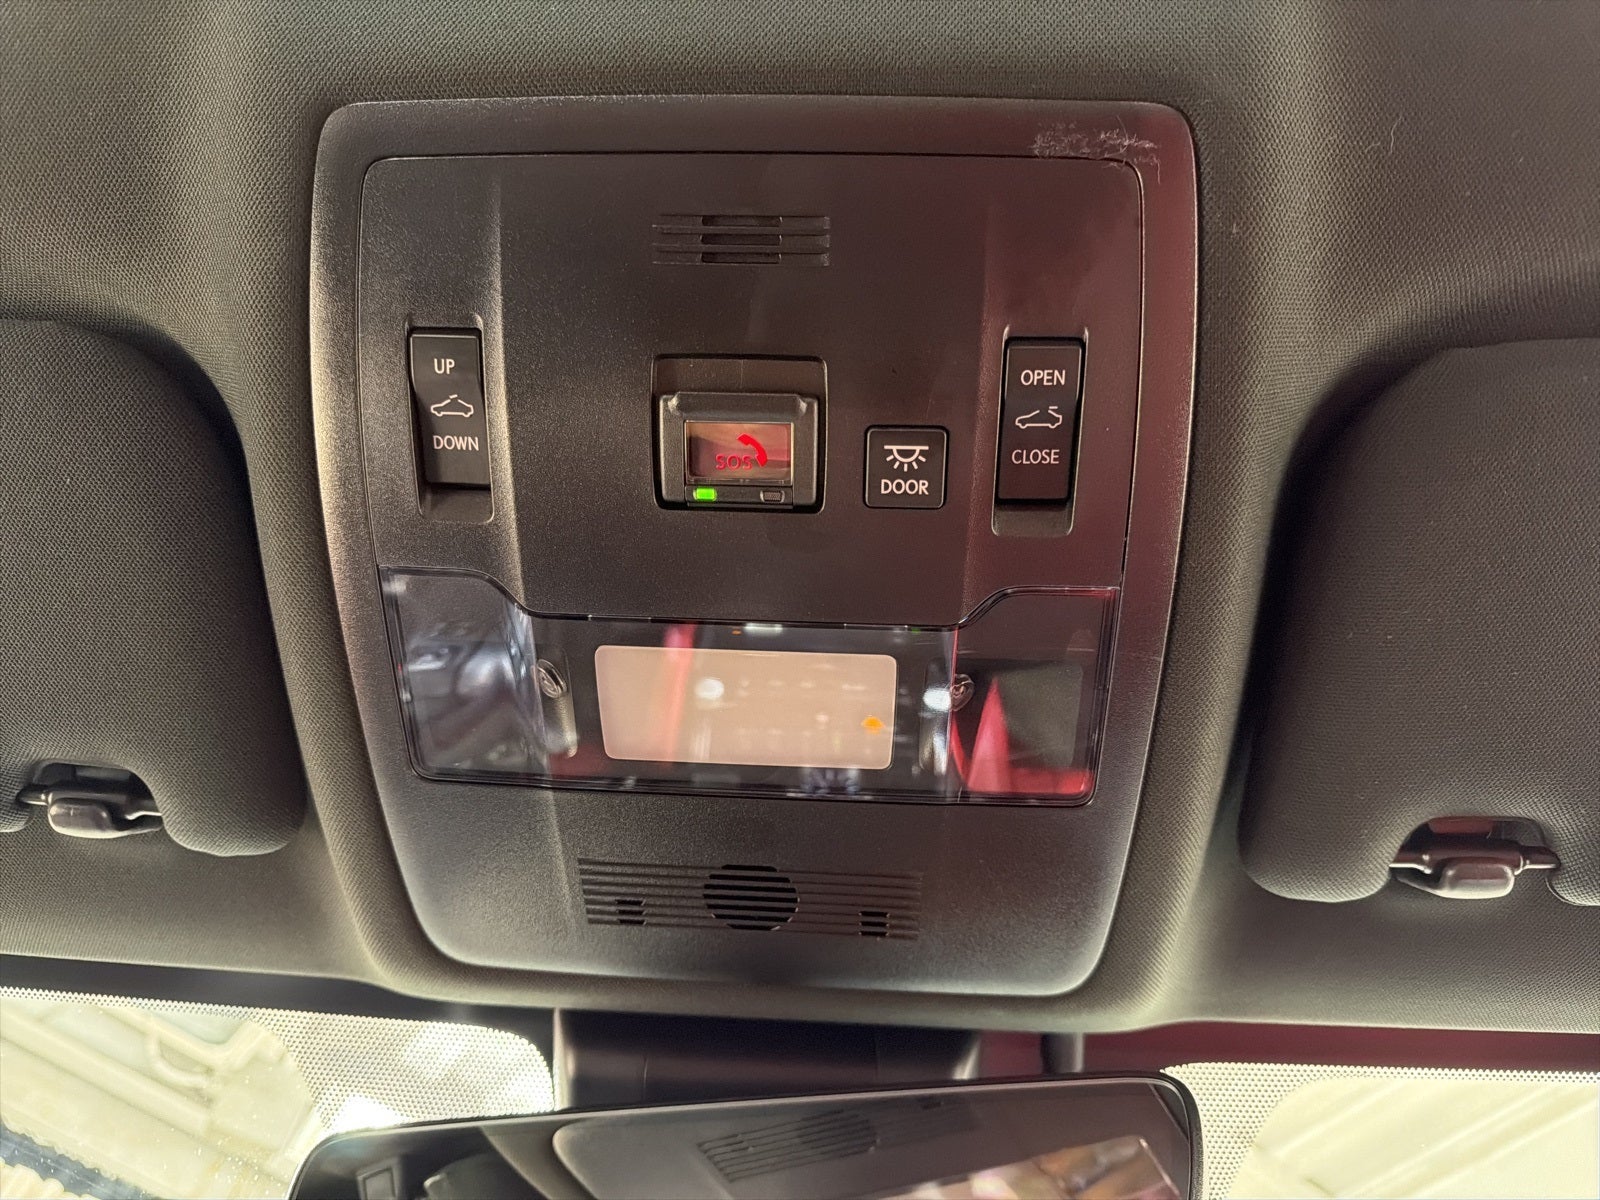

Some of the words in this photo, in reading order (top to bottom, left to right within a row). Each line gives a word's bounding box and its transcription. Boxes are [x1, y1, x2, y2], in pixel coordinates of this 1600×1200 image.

[434, 358, 455, 374] UP
[1020, 369, 1066, 386] OPEN
[433, 435, 479, 451] DOWN
[715, 454, 753, 470] SOS
[1011, 449, 1060, 464] CLOSE
[880, 478, 929, 495] DOOR
